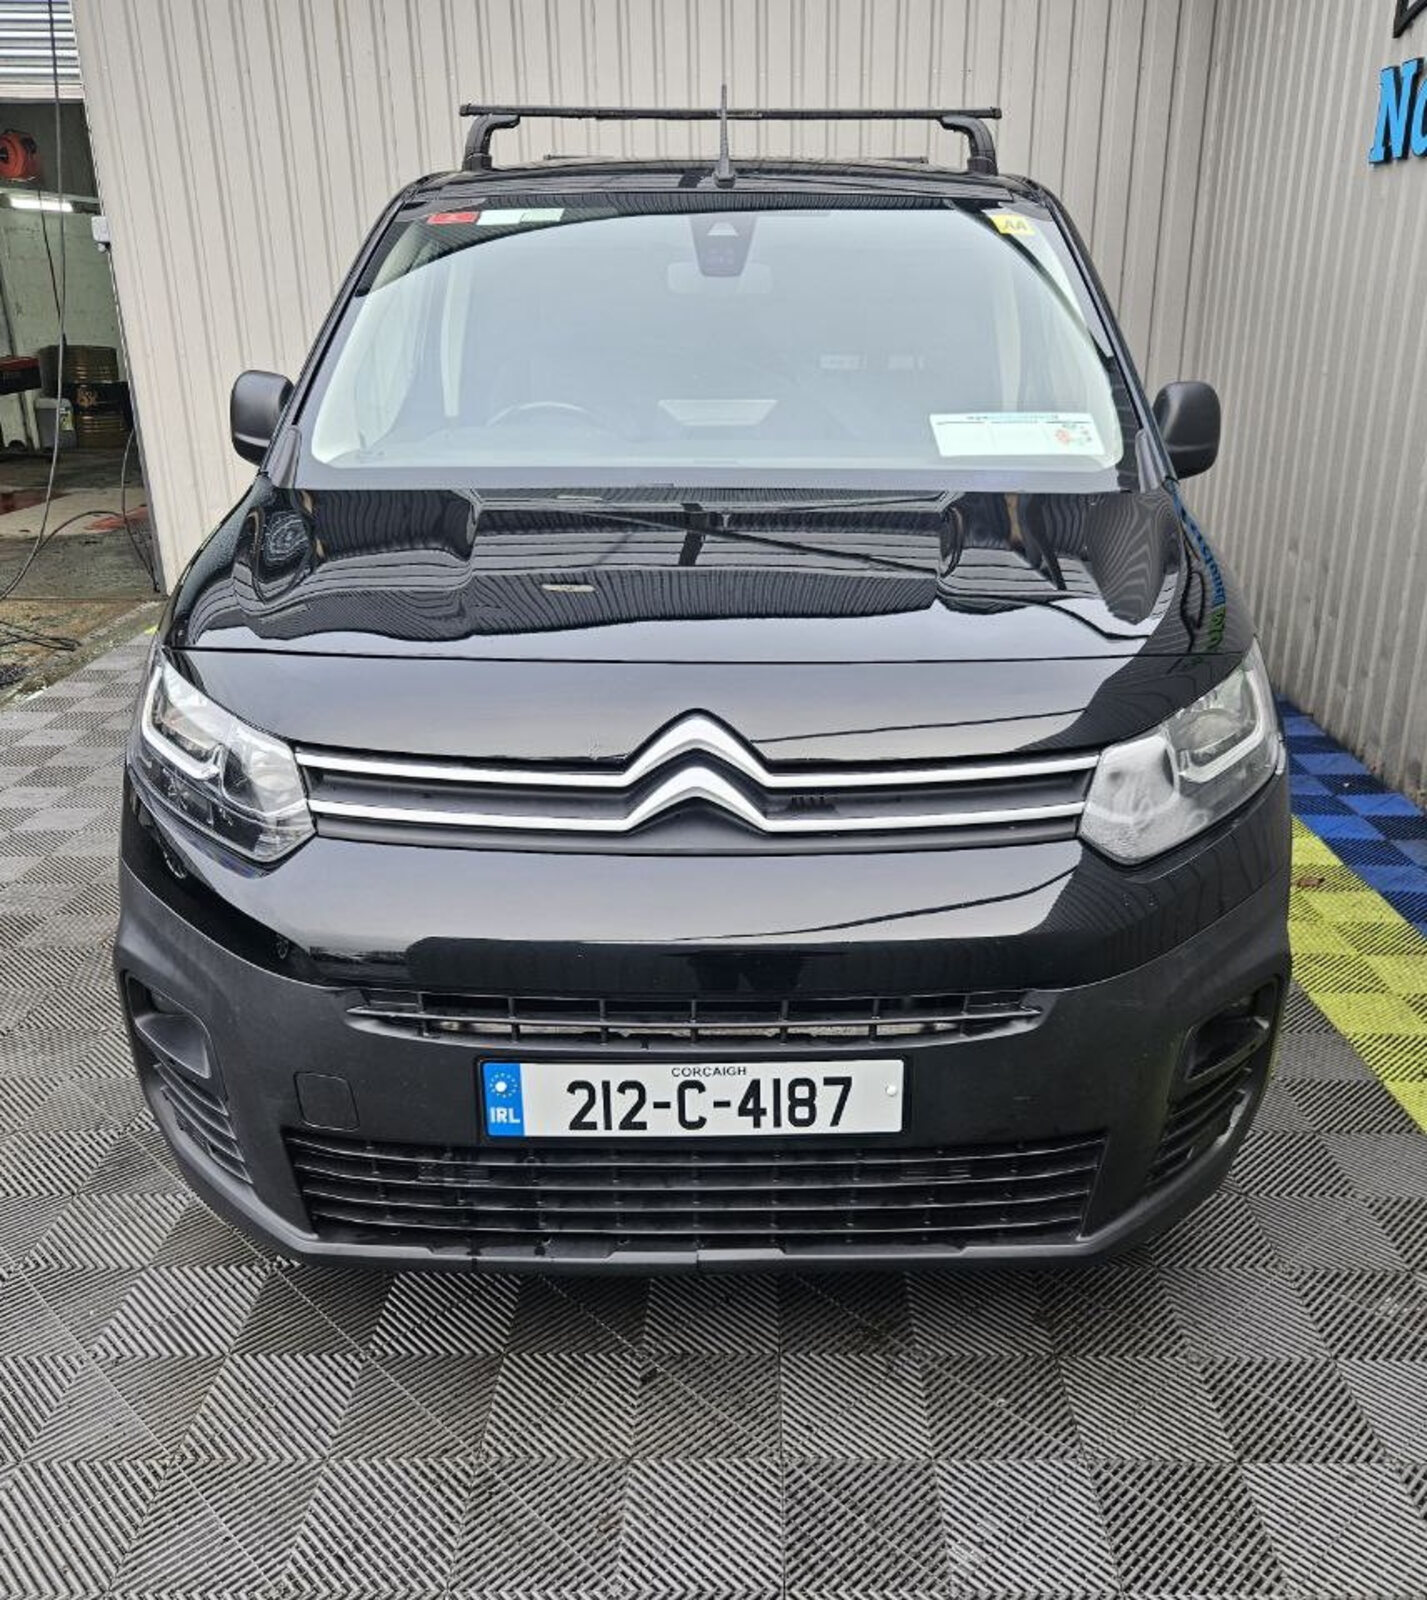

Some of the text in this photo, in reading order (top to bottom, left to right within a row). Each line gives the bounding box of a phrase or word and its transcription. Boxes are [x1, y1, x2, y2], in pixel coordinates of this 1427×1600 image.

[671, 1066, 747, 1077] CORCAIGH
[566, 1076, 853, 1131] 212-C-4187
[490, 1107, 521, 1124] IRL
